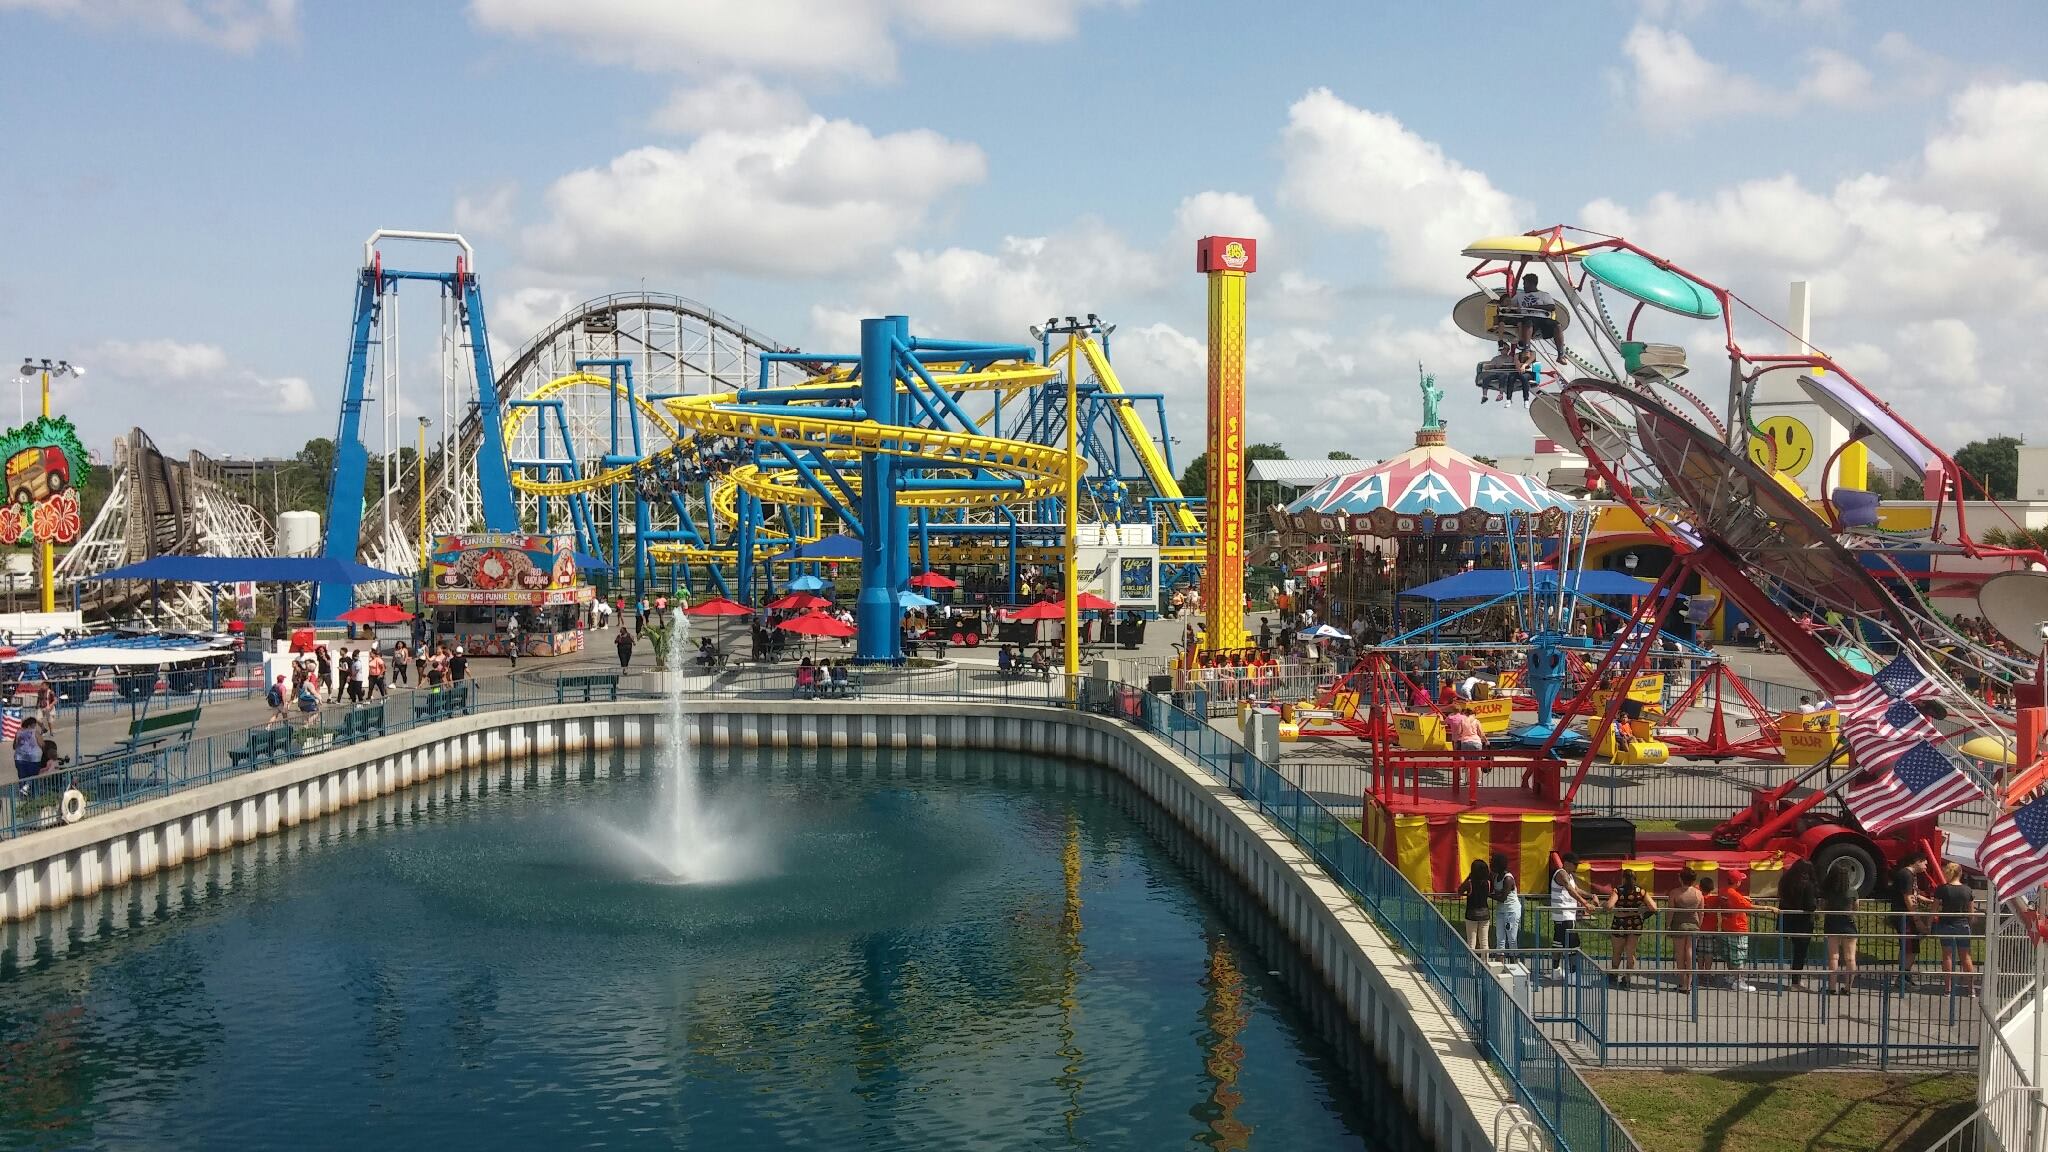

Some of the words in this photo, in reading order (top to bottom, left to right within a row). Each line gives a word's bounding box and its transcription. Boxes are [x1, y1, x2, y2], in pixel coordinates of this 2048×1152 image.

[1226, 416, 1239, 557] SCREAMER
[460, 535, 497, 547] FUNNEL
[501, 535, 526, 547] CAKE
[452, 592, 470, 600] CANDY
[485, 592, 511, 600] FUNNEL
[514, 592, 532, 600] CAKE
[1473, 704, 1501, 715] BLUR
[1790, 736, 1822, 748] BLUR
